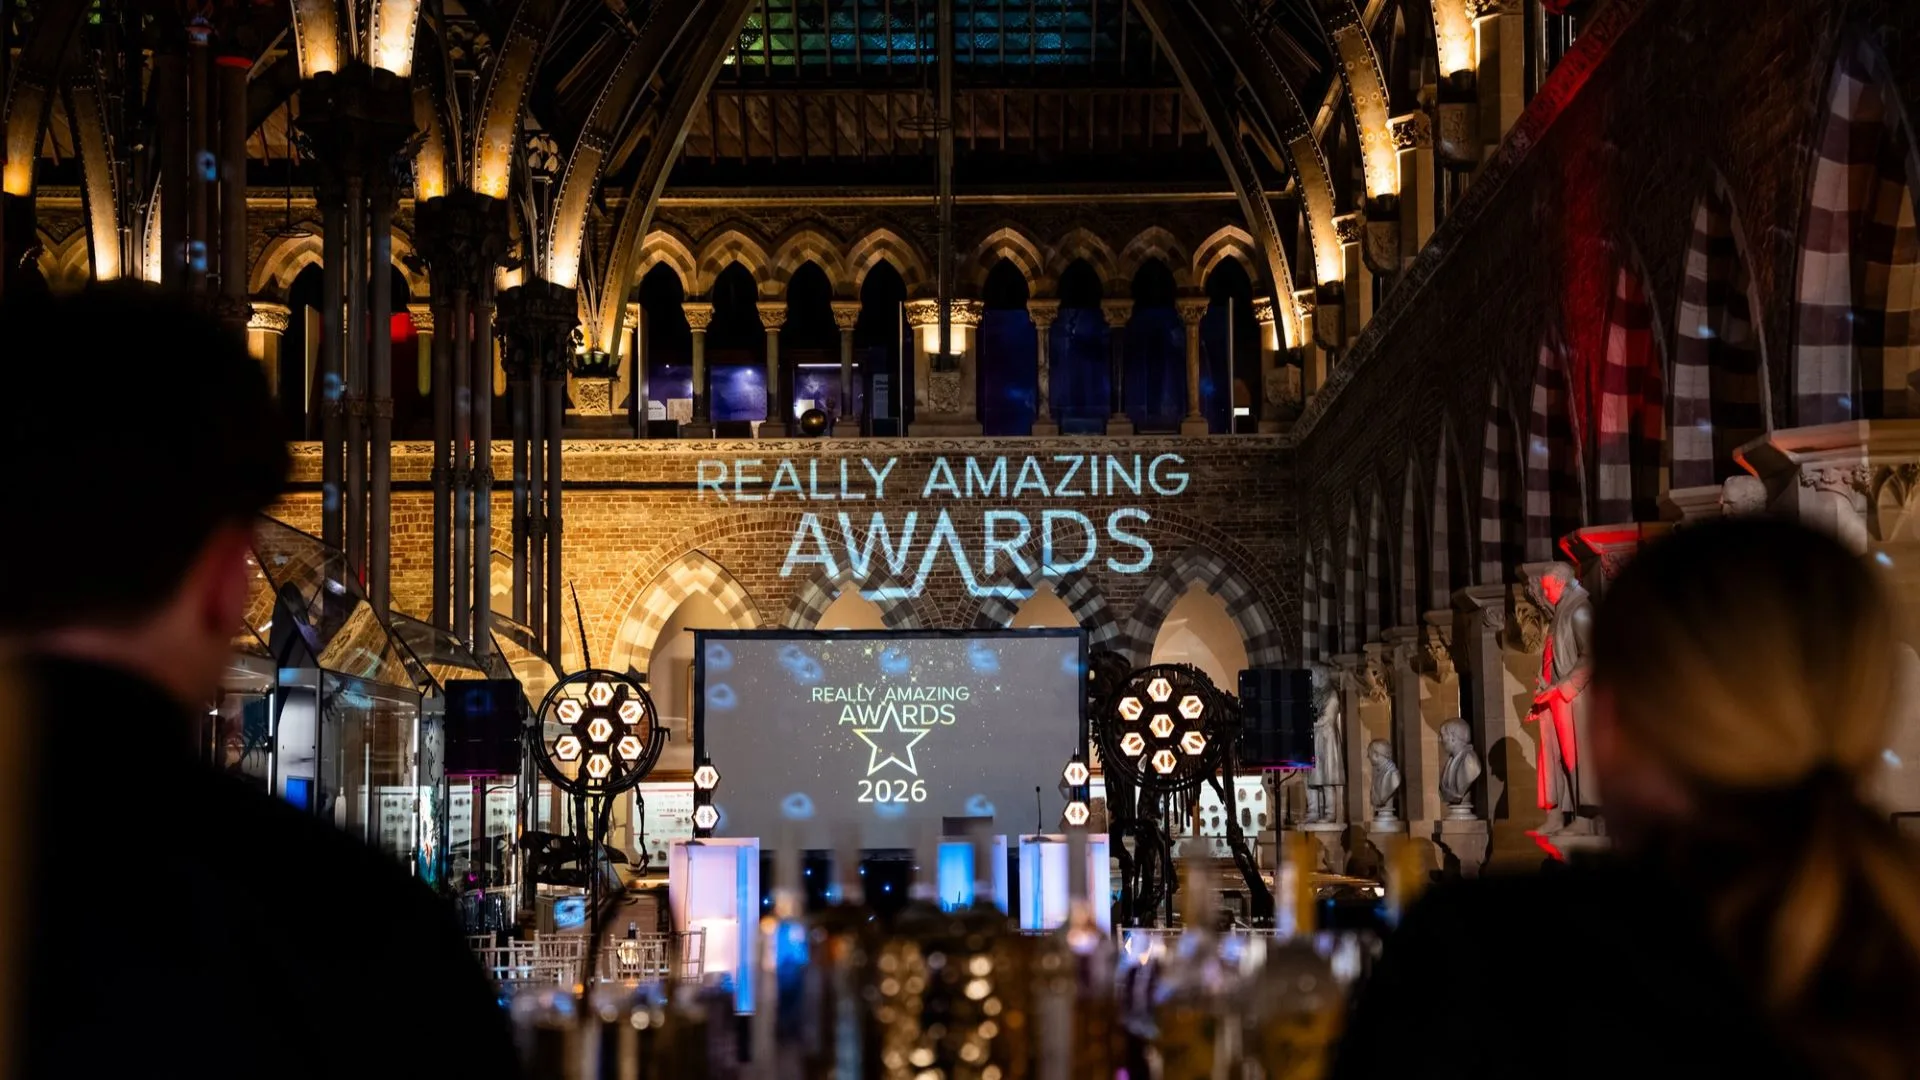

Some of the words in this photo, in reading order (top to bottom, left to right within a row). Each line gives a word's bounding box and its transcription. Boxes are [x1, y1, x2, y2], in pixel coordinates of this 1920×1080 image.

[696, 457, 897, 502] REALLY
[922, 453, 1190, 498] AMAZING
[779, 507, 1154, 599] AWARDS
[812, 687, 876, 702] REALLY
[884, 686, 970, 702] AMAZING
[838, 702, 956, 726] AWARDS
[857, 779, 928, 803] 2026
